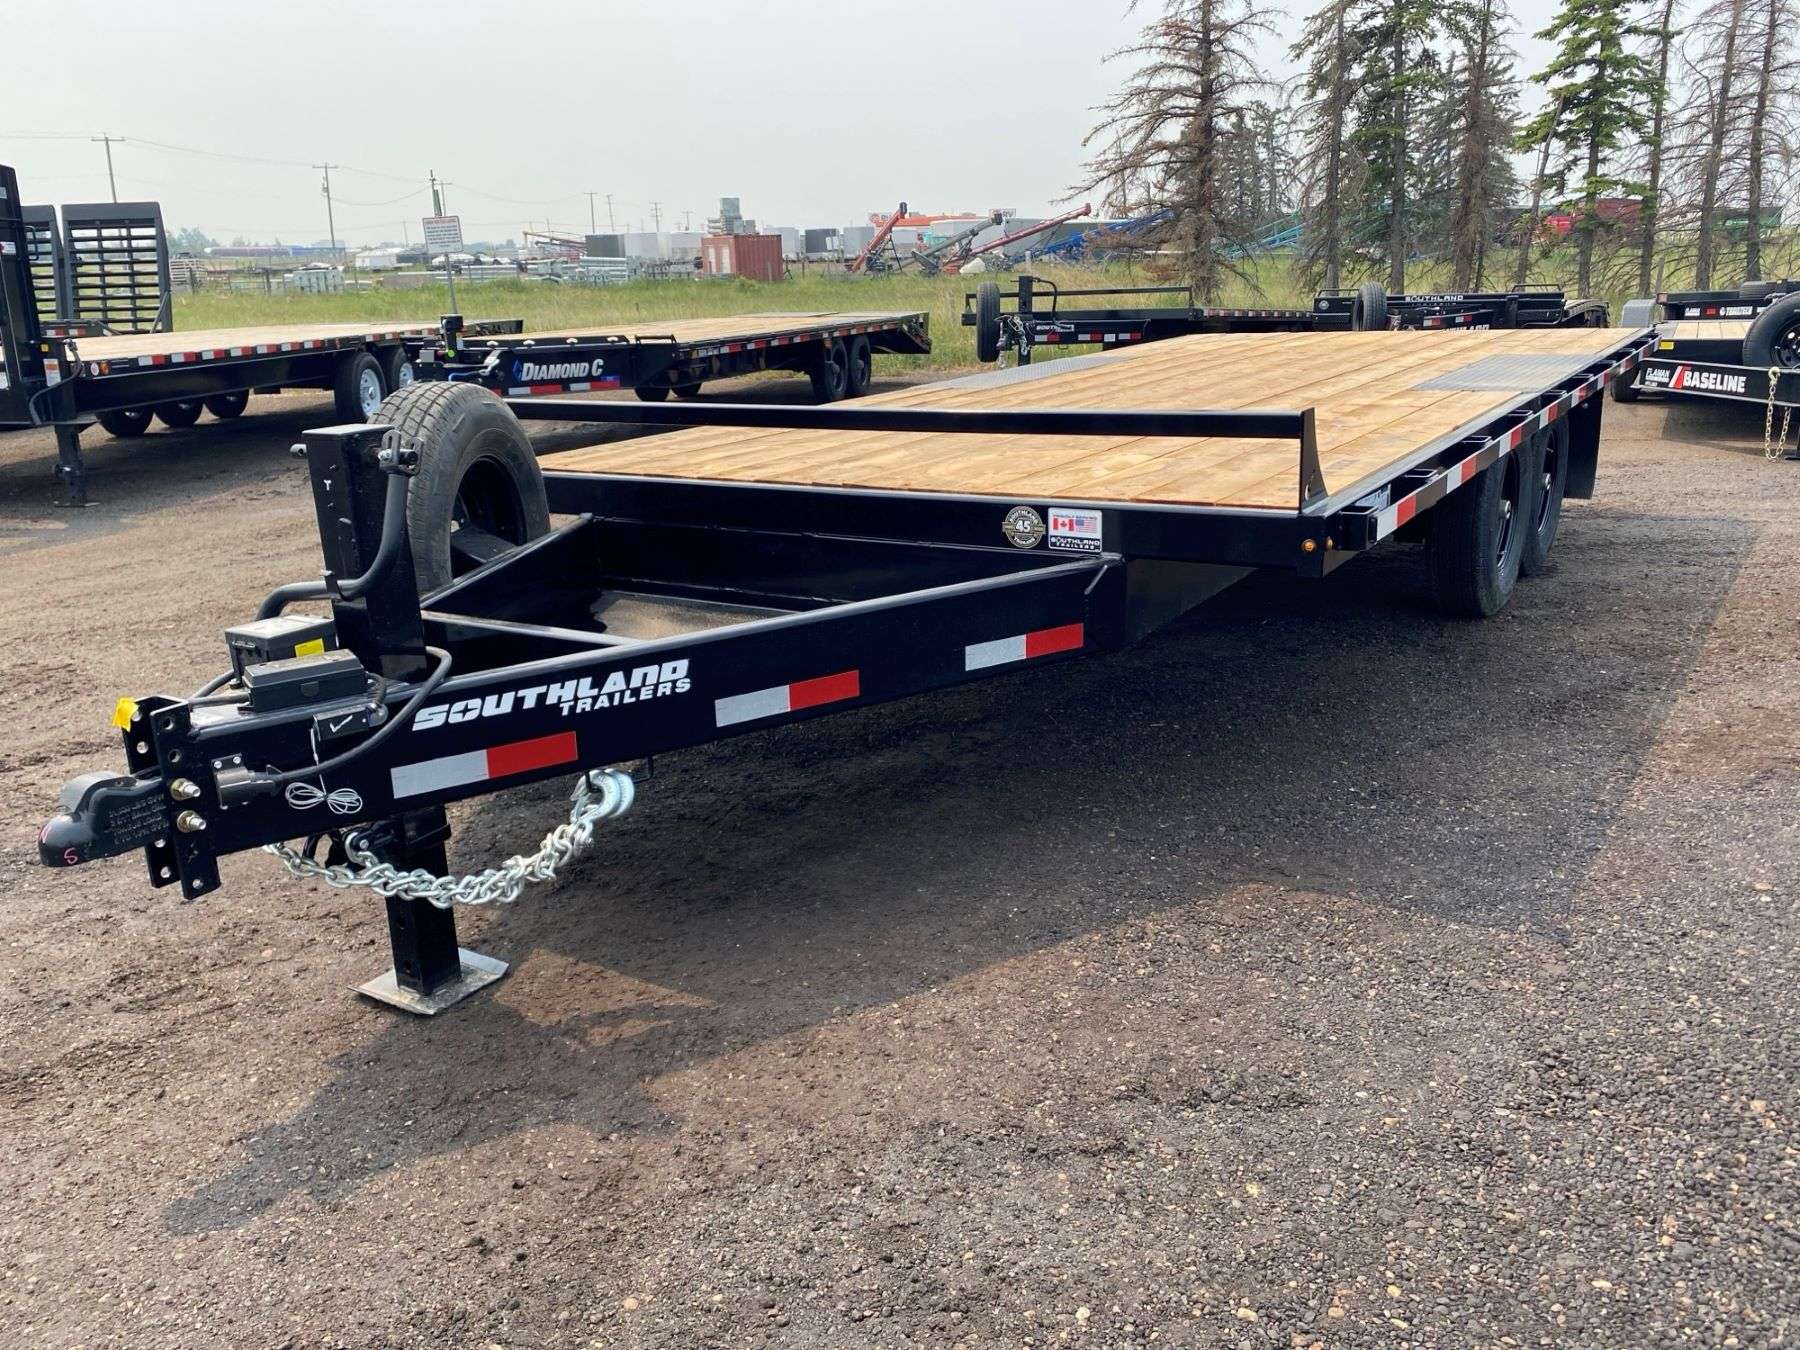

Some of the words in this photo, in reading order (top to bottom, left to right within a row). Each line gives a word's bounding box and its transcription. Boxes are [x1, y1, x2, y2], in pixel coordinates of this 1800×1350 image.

[521, 362, 590, 381] DIAMOND
[591, 359, 604, 376] C
[1683, 370, 1747, 393] BASELINE
[1015, 520, 1031, 533] 45
[1050, 537, 1100, 546] SOUTHLAND
[1056, 541, 1095, 549] TRAILERS
[411, 659, 690, 732] SOUTHLAND
[558, 677, 691, 717] TRAILERS
